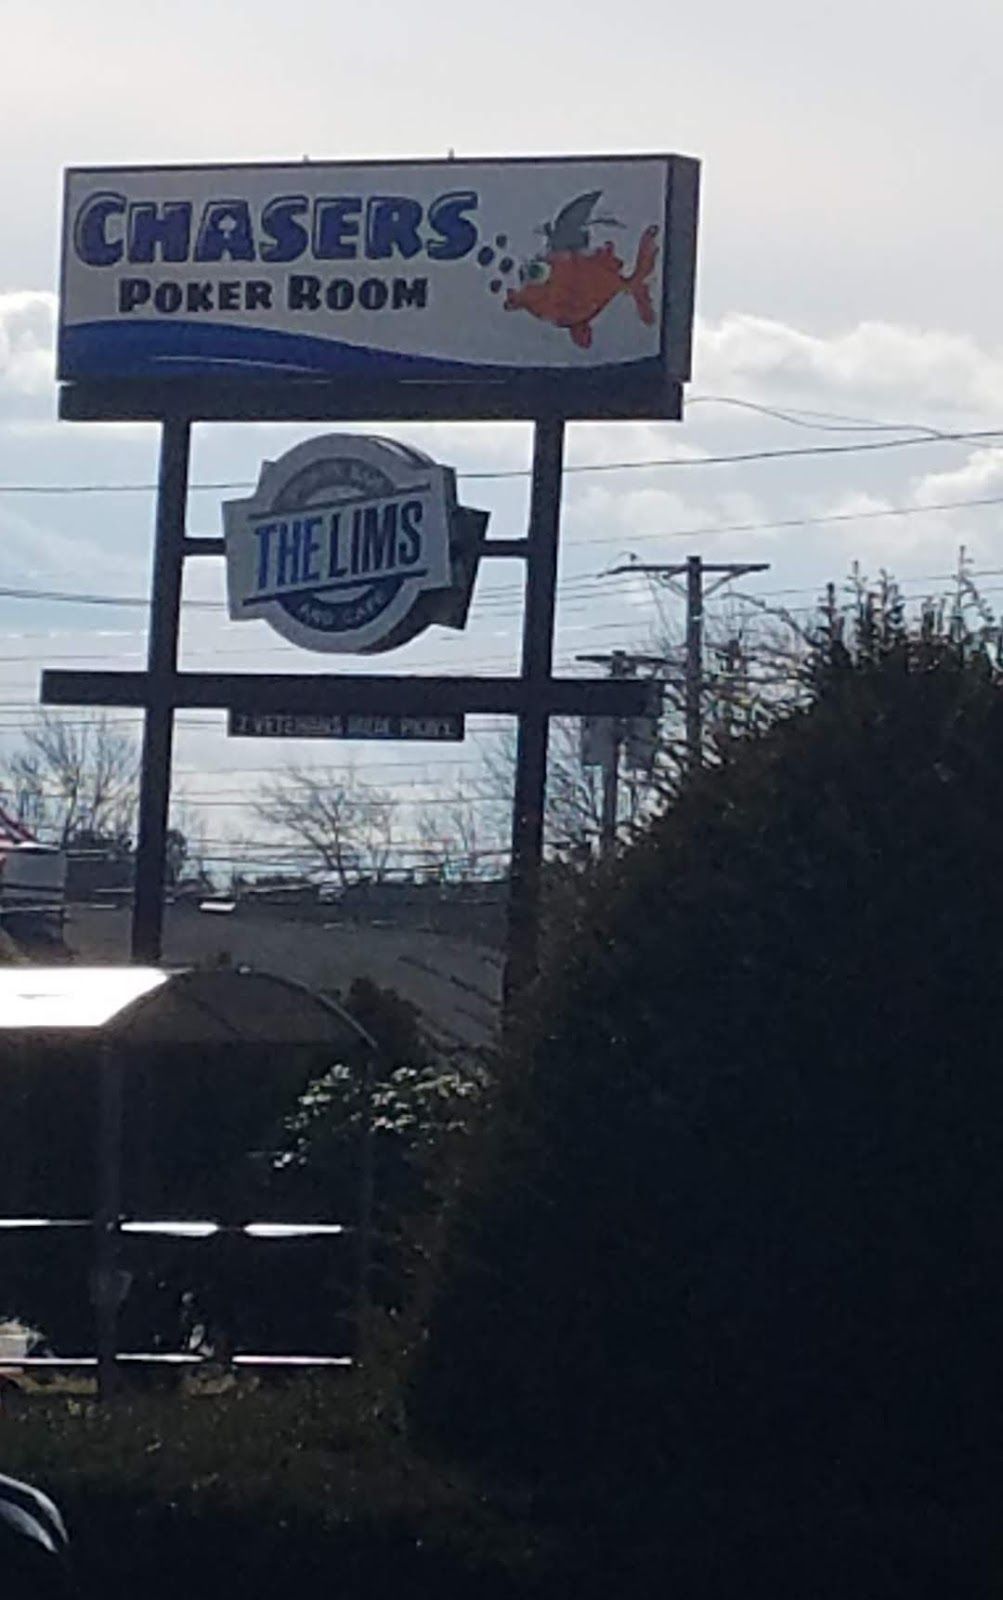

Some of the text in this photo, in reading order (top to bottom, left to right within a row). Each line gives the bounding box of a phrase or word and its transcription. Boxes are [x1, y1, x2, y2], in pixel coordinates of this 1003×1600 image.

[75, 191, 478, 267] CHASERS
[119, 274, 428, 313] POKER ROOM
[255, 501, 423, 591] THE LIMS
